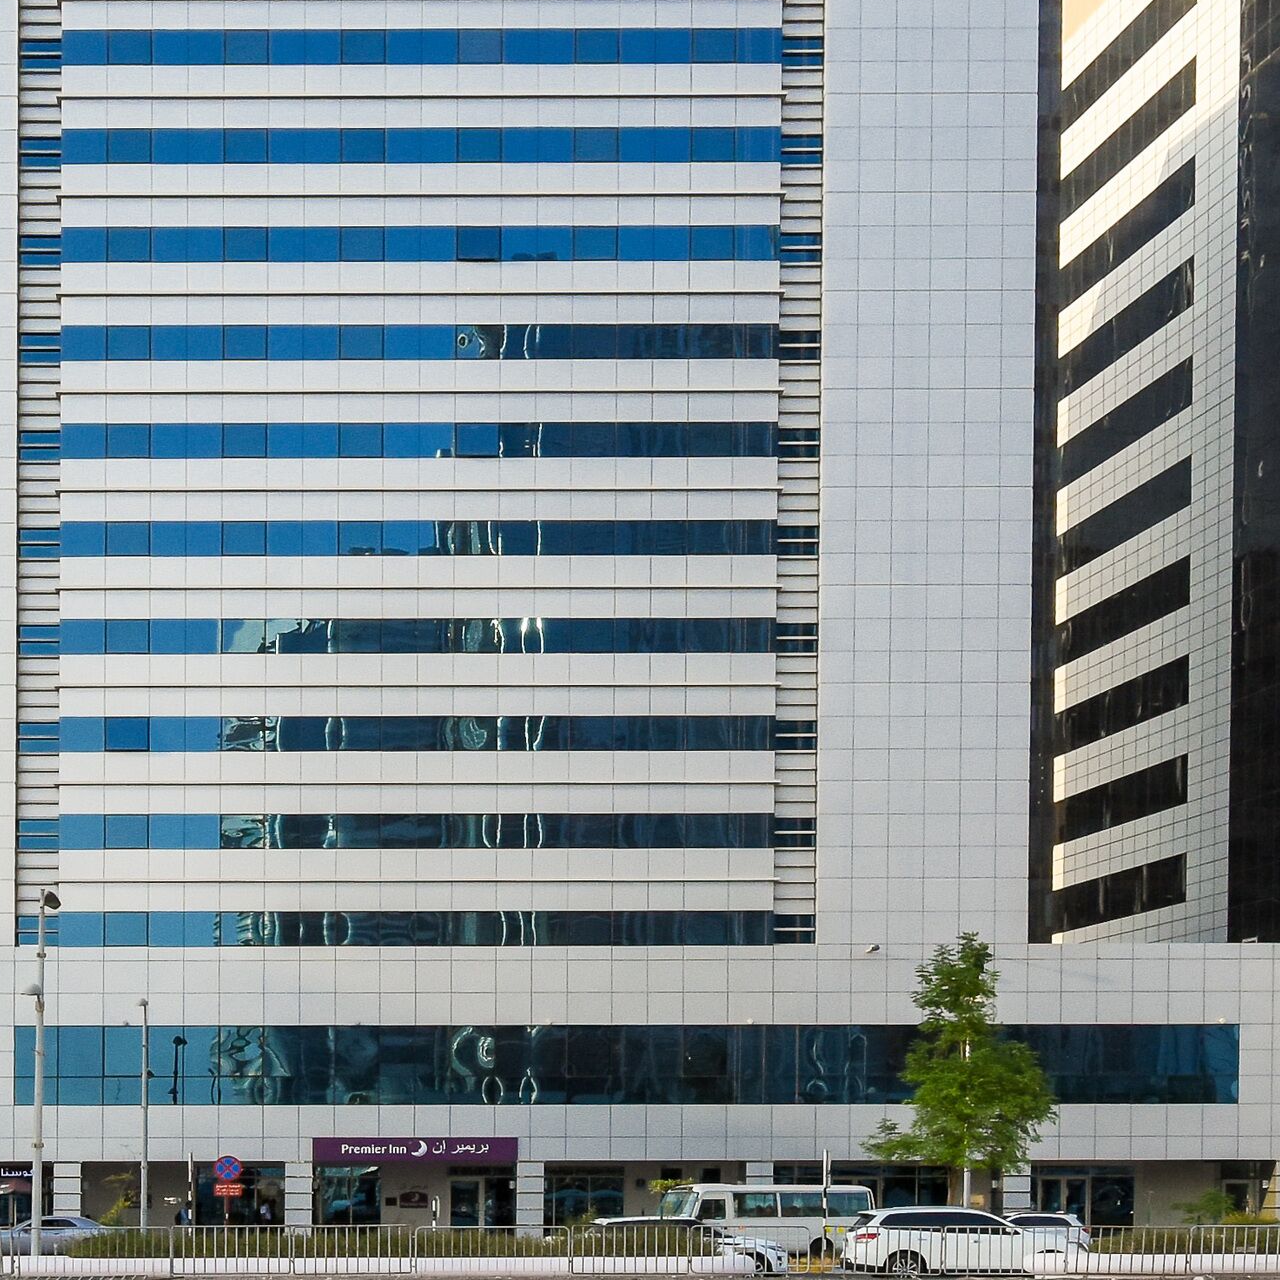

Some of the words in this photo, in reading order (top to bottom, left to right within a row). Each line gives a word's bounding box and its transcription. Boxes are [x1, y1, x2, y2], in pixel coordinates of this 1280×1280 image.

[341, 1143, 387, 1155] Premier
[389, 1143, 407, 1155] Inn
[432, 1140, 447, 1155] إن
[451, 1142, 490, 1154] بريمير
